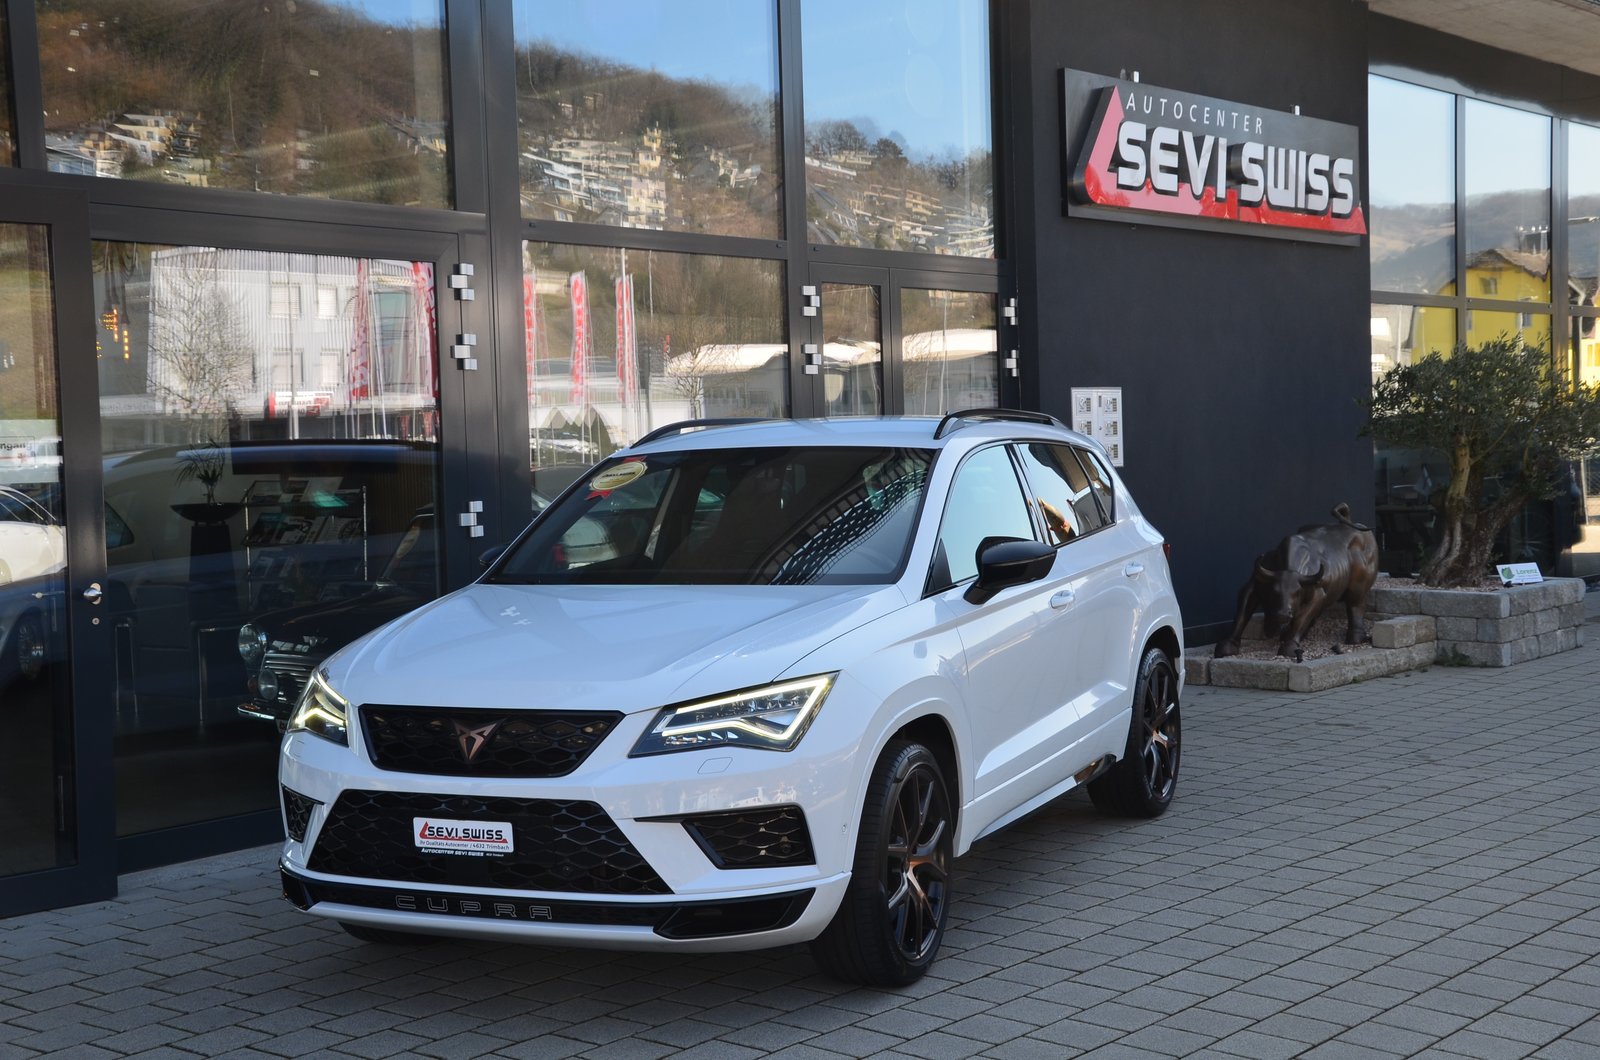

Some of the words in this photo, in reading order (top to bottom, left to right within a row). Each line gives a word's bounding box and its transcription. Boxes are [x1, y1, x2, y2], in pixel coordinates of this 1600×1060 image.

[1126, 92, 1263, 134] AUTOCENTER
[1116, 120, 1227, 200] SEVI
[1241, 141, 1353, 215] SWISS
[428, 826, 458, 838] SEVI
[462, 829, 503, 840] SWISS
[395, 894, 552, 920] CUPRA
